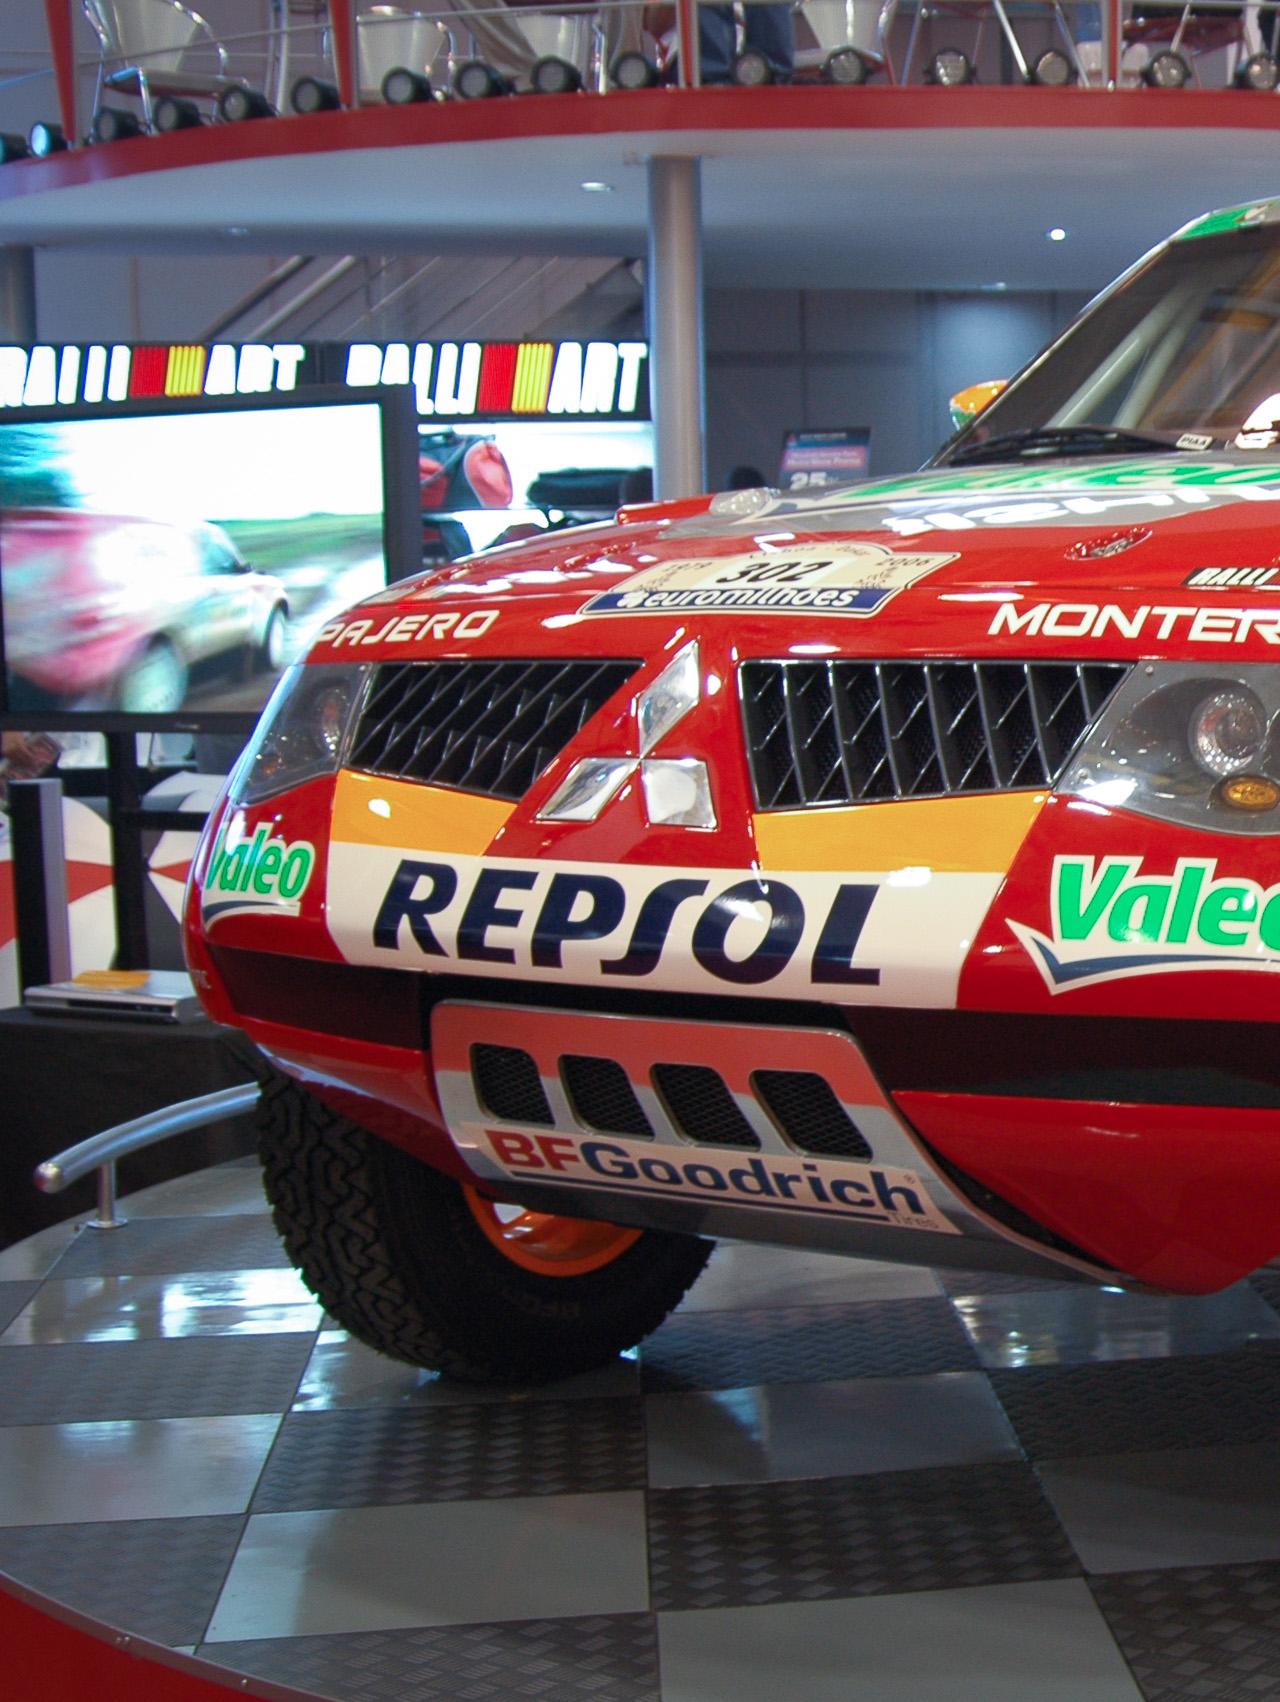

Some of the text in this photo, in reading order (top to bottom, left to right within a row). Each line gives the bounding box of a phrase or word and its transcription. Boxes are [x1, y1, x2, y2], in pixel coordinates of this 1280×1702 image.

[715, 560, 834, 585] 302
[316, 609, 501, 648] PAJERO
[206, 824, 313, 899] Valeo
[371, 858, 881, 986] REPSOL
[484, 1128, 925, 1216] BFGoodrich
